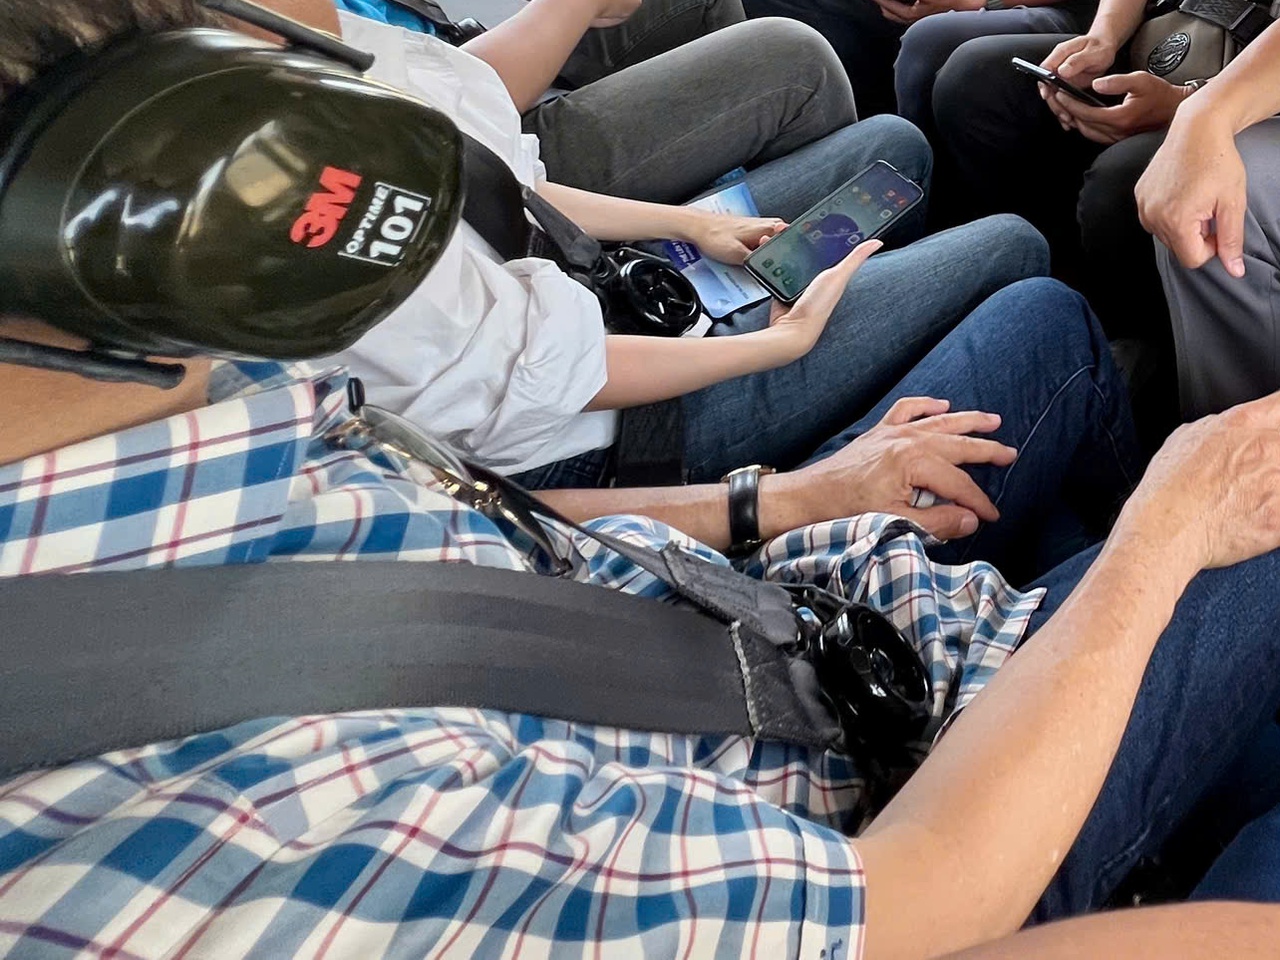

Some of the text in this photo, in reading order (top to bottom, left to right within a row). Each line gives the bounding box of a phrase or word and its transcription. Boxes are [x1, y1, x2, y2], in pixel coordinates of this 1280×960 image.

[289, 165, 363, 249] 3M
[345, 186, 391, 254] OPTIME
[369, 195, 424, 258] 101
